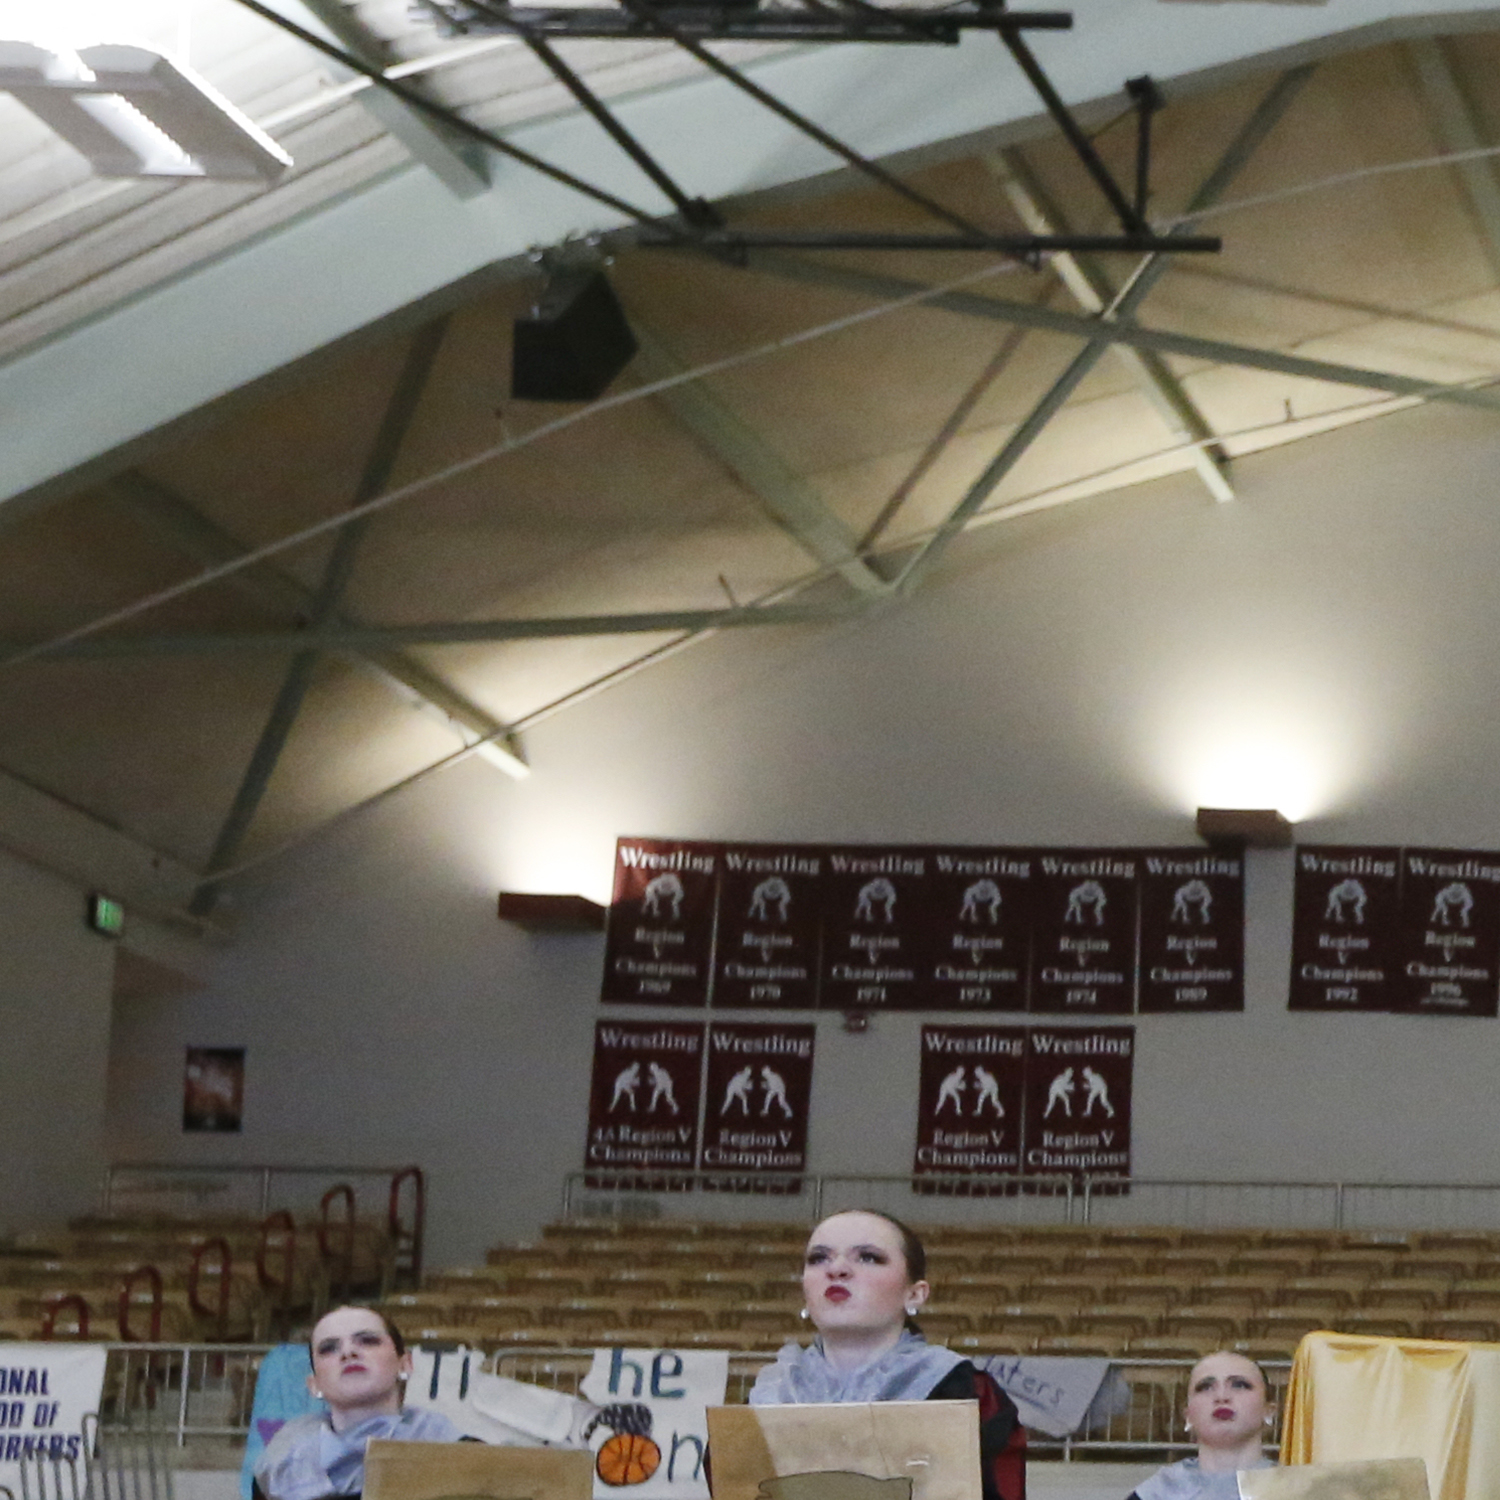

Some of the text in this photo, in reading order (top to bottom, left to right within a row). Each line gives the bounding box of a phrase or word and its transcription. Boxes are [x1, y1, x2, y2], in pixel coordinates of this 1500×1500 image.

[620, 846, 714, 874] Wrestling
[725, 852, 820, 875] Wrestling
[831, 854, 925, 875] Wrestling
[936, 855, 1030, 878] Wrestling
[1041, 856, 1136, 879] Wrestling
[1146, 856, 1240, 878] Wrestling
[1301, 854, 1396, 878] Wrestling
[600, 1028, 699, 1053] Wrestling
[712, 1031, 812, 1058] Wrestling
[925, 1032, 1024, 1058] Wrestling
[1032, 1033, 1131, 1058] Wrestling
[620, 1125, 676, 1145] Region
[678, 1127, 691, 1144] V
[720, 1129, 792, 1147] Region V
[933, 1130, 1005, 1149] Region V
[1042, 1130, 1114, 1149] Region V
[590, 1146, 691, 1165] Champions
[704, 1149, 802, 1168] Champions
[917, 1148, 1018, 1168] Champions
[1027, 1150, 1128, 1169] Champions
[34, 1401, 60, 1428] OF
